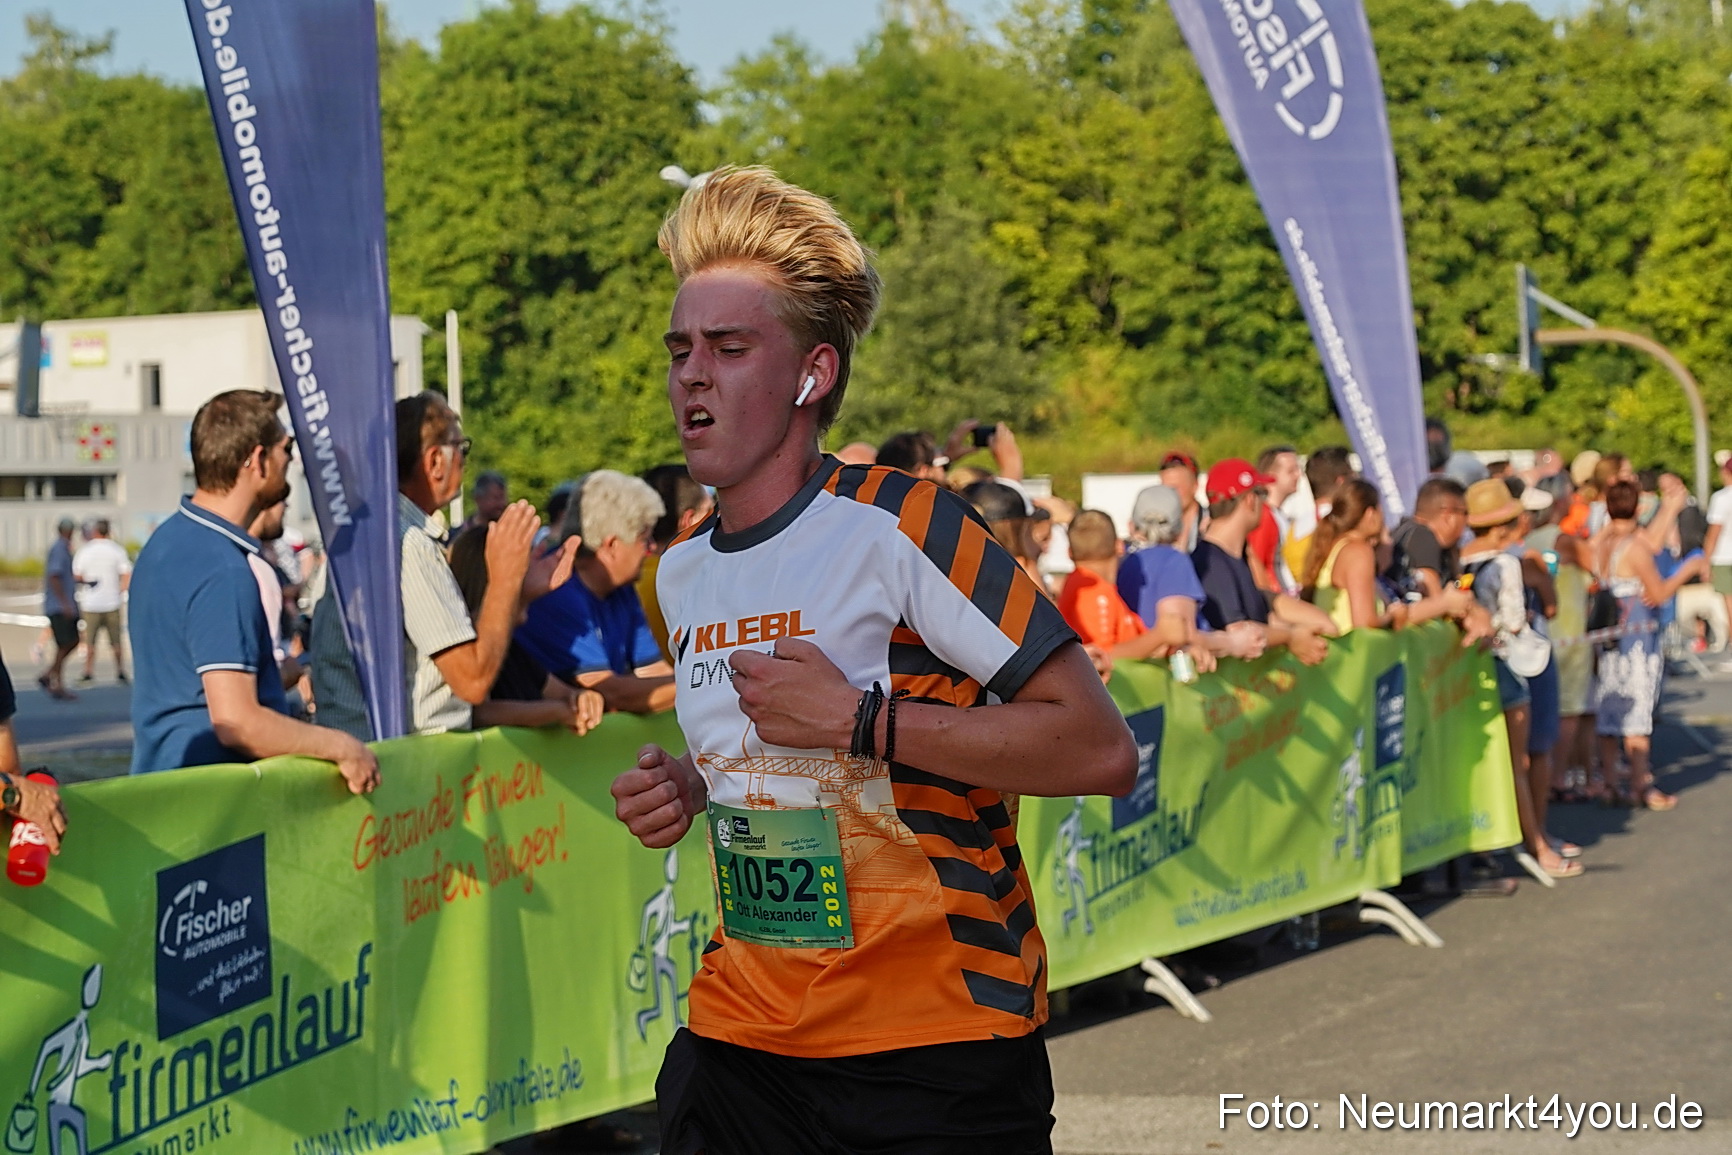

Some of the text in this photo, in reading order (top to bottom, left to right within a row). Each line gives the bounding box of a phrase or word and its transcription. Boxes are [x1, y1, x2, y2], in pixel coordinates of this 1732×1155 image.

[694, 609, 815, 653] KLEBL
[461, 761, 544, 822] Firmen
[720, 865, 734, 911] RUN
[729, 853, 819, 903] 1052
[820, 865, 843, 928] 2022
[176, 895, 252, 946] Fischer
[736, 901, 818, 923] Ott Alexander
[109, 942, 372, 1142] firmenlauf
